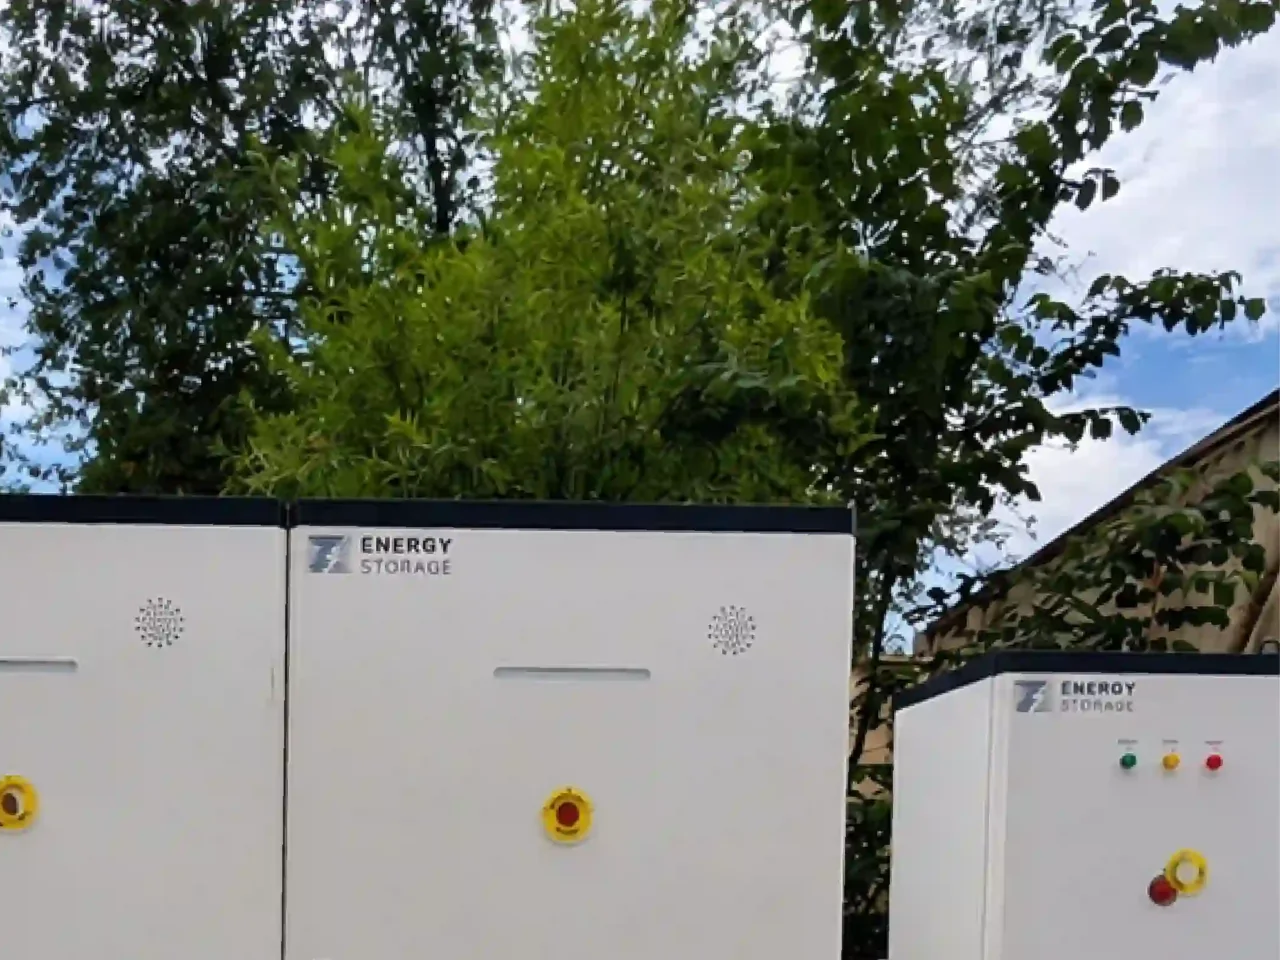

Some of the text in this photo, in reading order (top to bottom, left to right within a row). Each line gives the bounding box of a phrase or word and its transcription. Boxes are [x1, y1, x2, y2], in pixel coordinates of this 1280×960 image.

[361, 536, 453, 554] ENERGY
[361, 558, 452, 575] STORAGE
[1061, 681, 1136, 696] ENERGY
